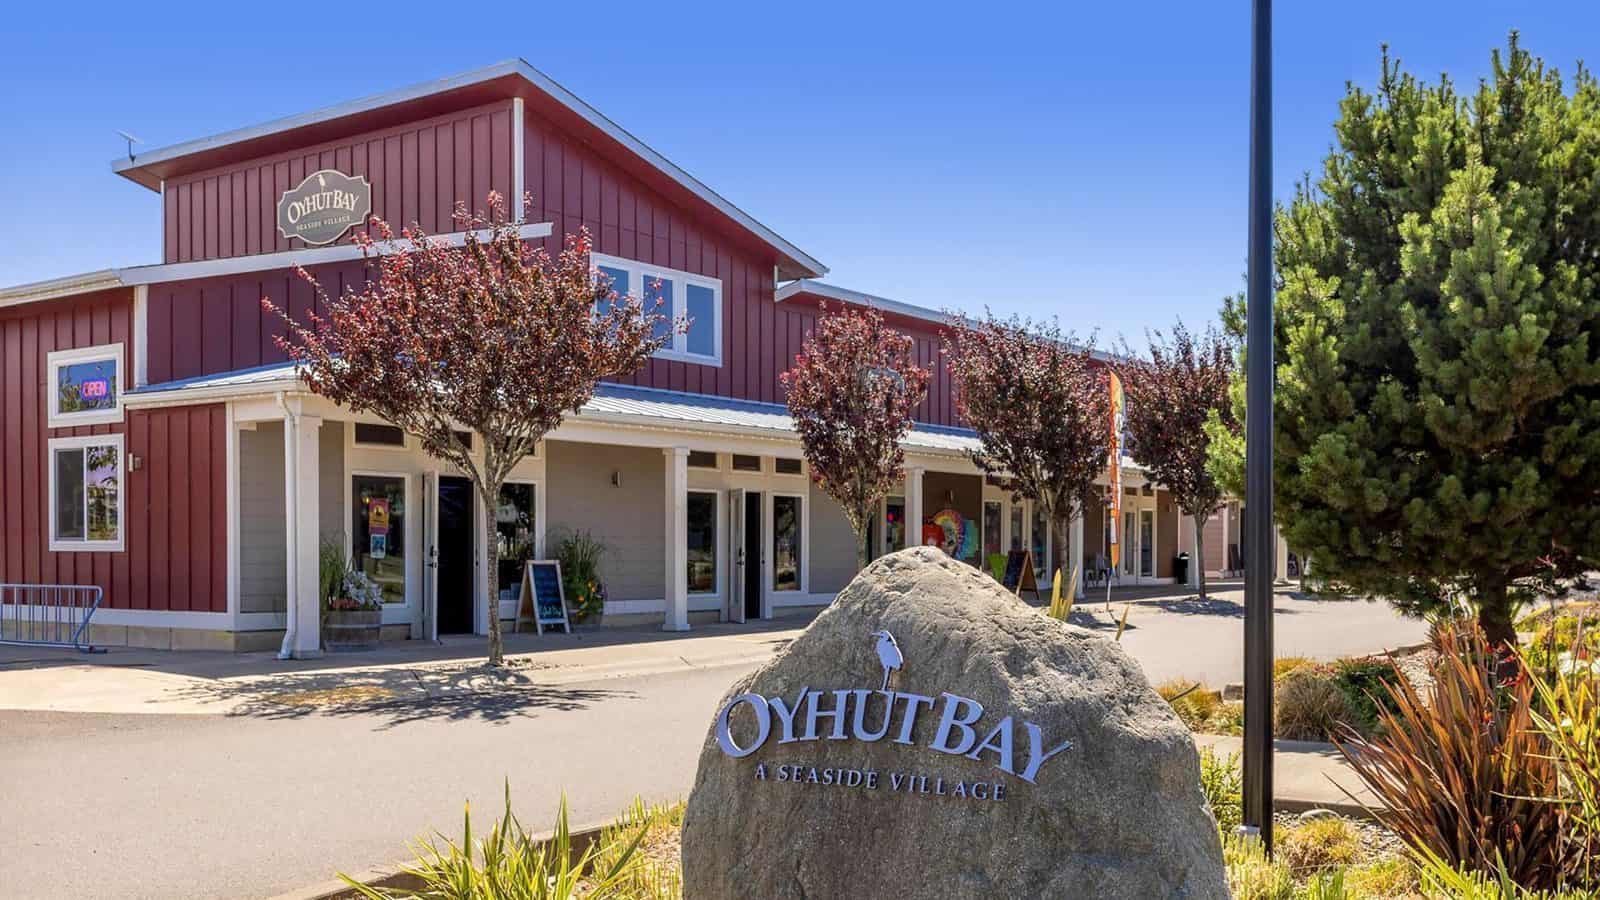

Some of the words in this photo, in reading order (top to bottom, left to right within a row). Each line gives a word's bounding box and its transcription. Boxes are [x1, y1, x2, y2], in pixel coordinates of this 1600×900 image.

[83, 381, 107, 397] OPEN
[754, 764, 768, 781] A
[777, 765, 880, 790] SEASIDE
[890, 774, 1009, 801] VILLAGE
